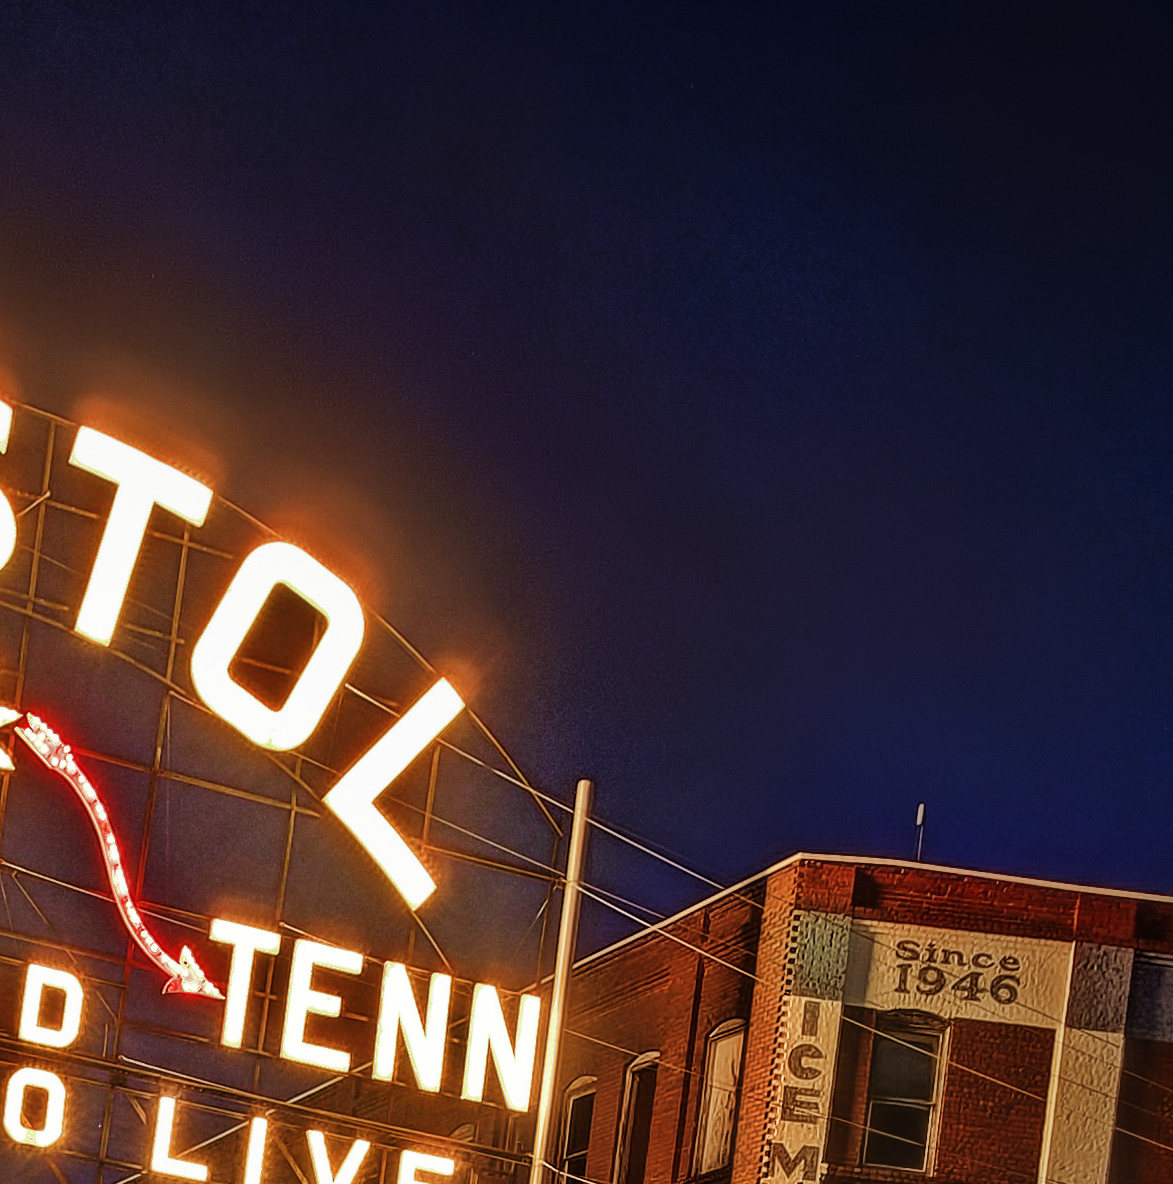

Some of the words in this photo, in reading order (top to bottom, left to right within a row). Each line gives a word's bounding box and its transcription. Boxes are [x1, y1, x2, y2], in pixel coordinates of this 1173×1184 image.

[894, 963, 1021, 1005] 1946
[896, 939, 1021, 972] Since
[209, 918, 541, 1113] TENN
[780, 1000, 824, 1124] ICE
